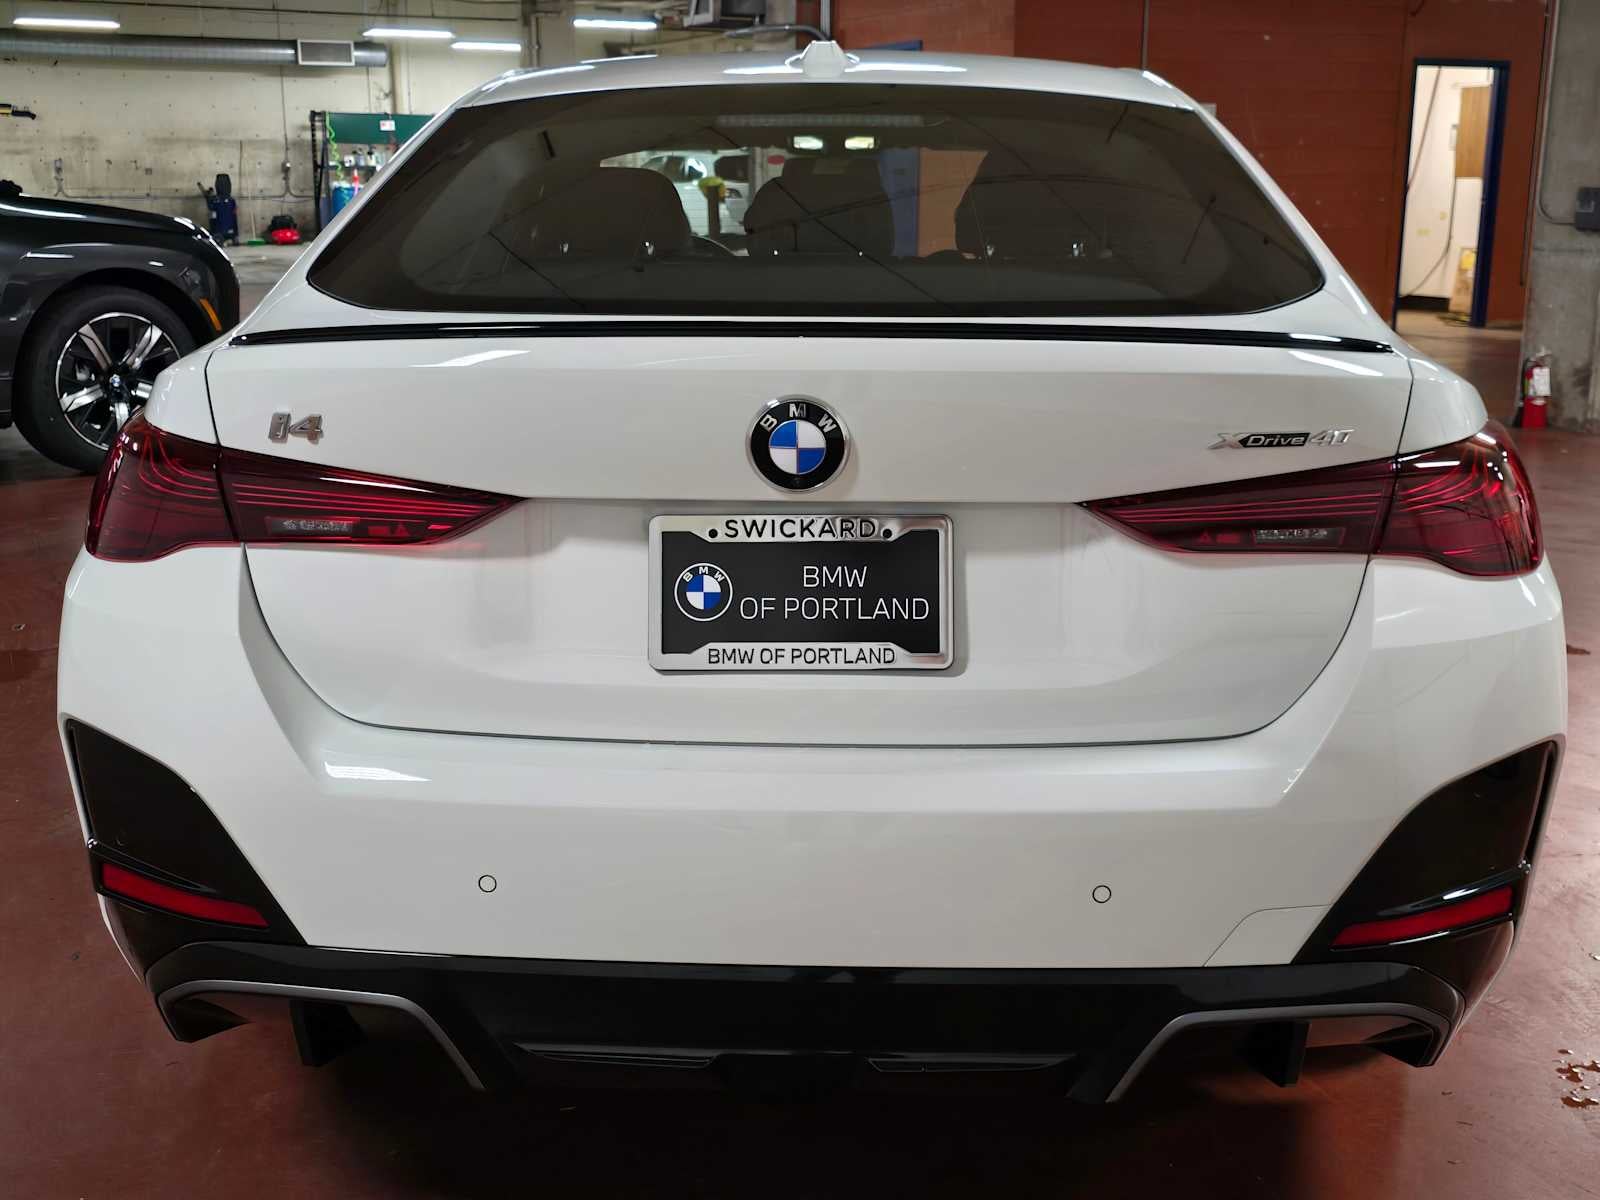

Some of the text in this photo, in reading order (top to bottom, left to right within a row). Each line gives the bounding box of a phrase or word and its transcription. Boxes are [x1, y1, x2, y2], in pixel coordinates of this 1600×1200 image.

[759, 403, 838, 432] BMW
[724, 519, 877, 539] SWICKARD
[682, 566, 726, 583] BMW
[803, 565, 868, 588] BMW
[740, 597, 930, 621] OF PORTLAND
[707, 647, 896, 664] BMW OF PORTLAND
